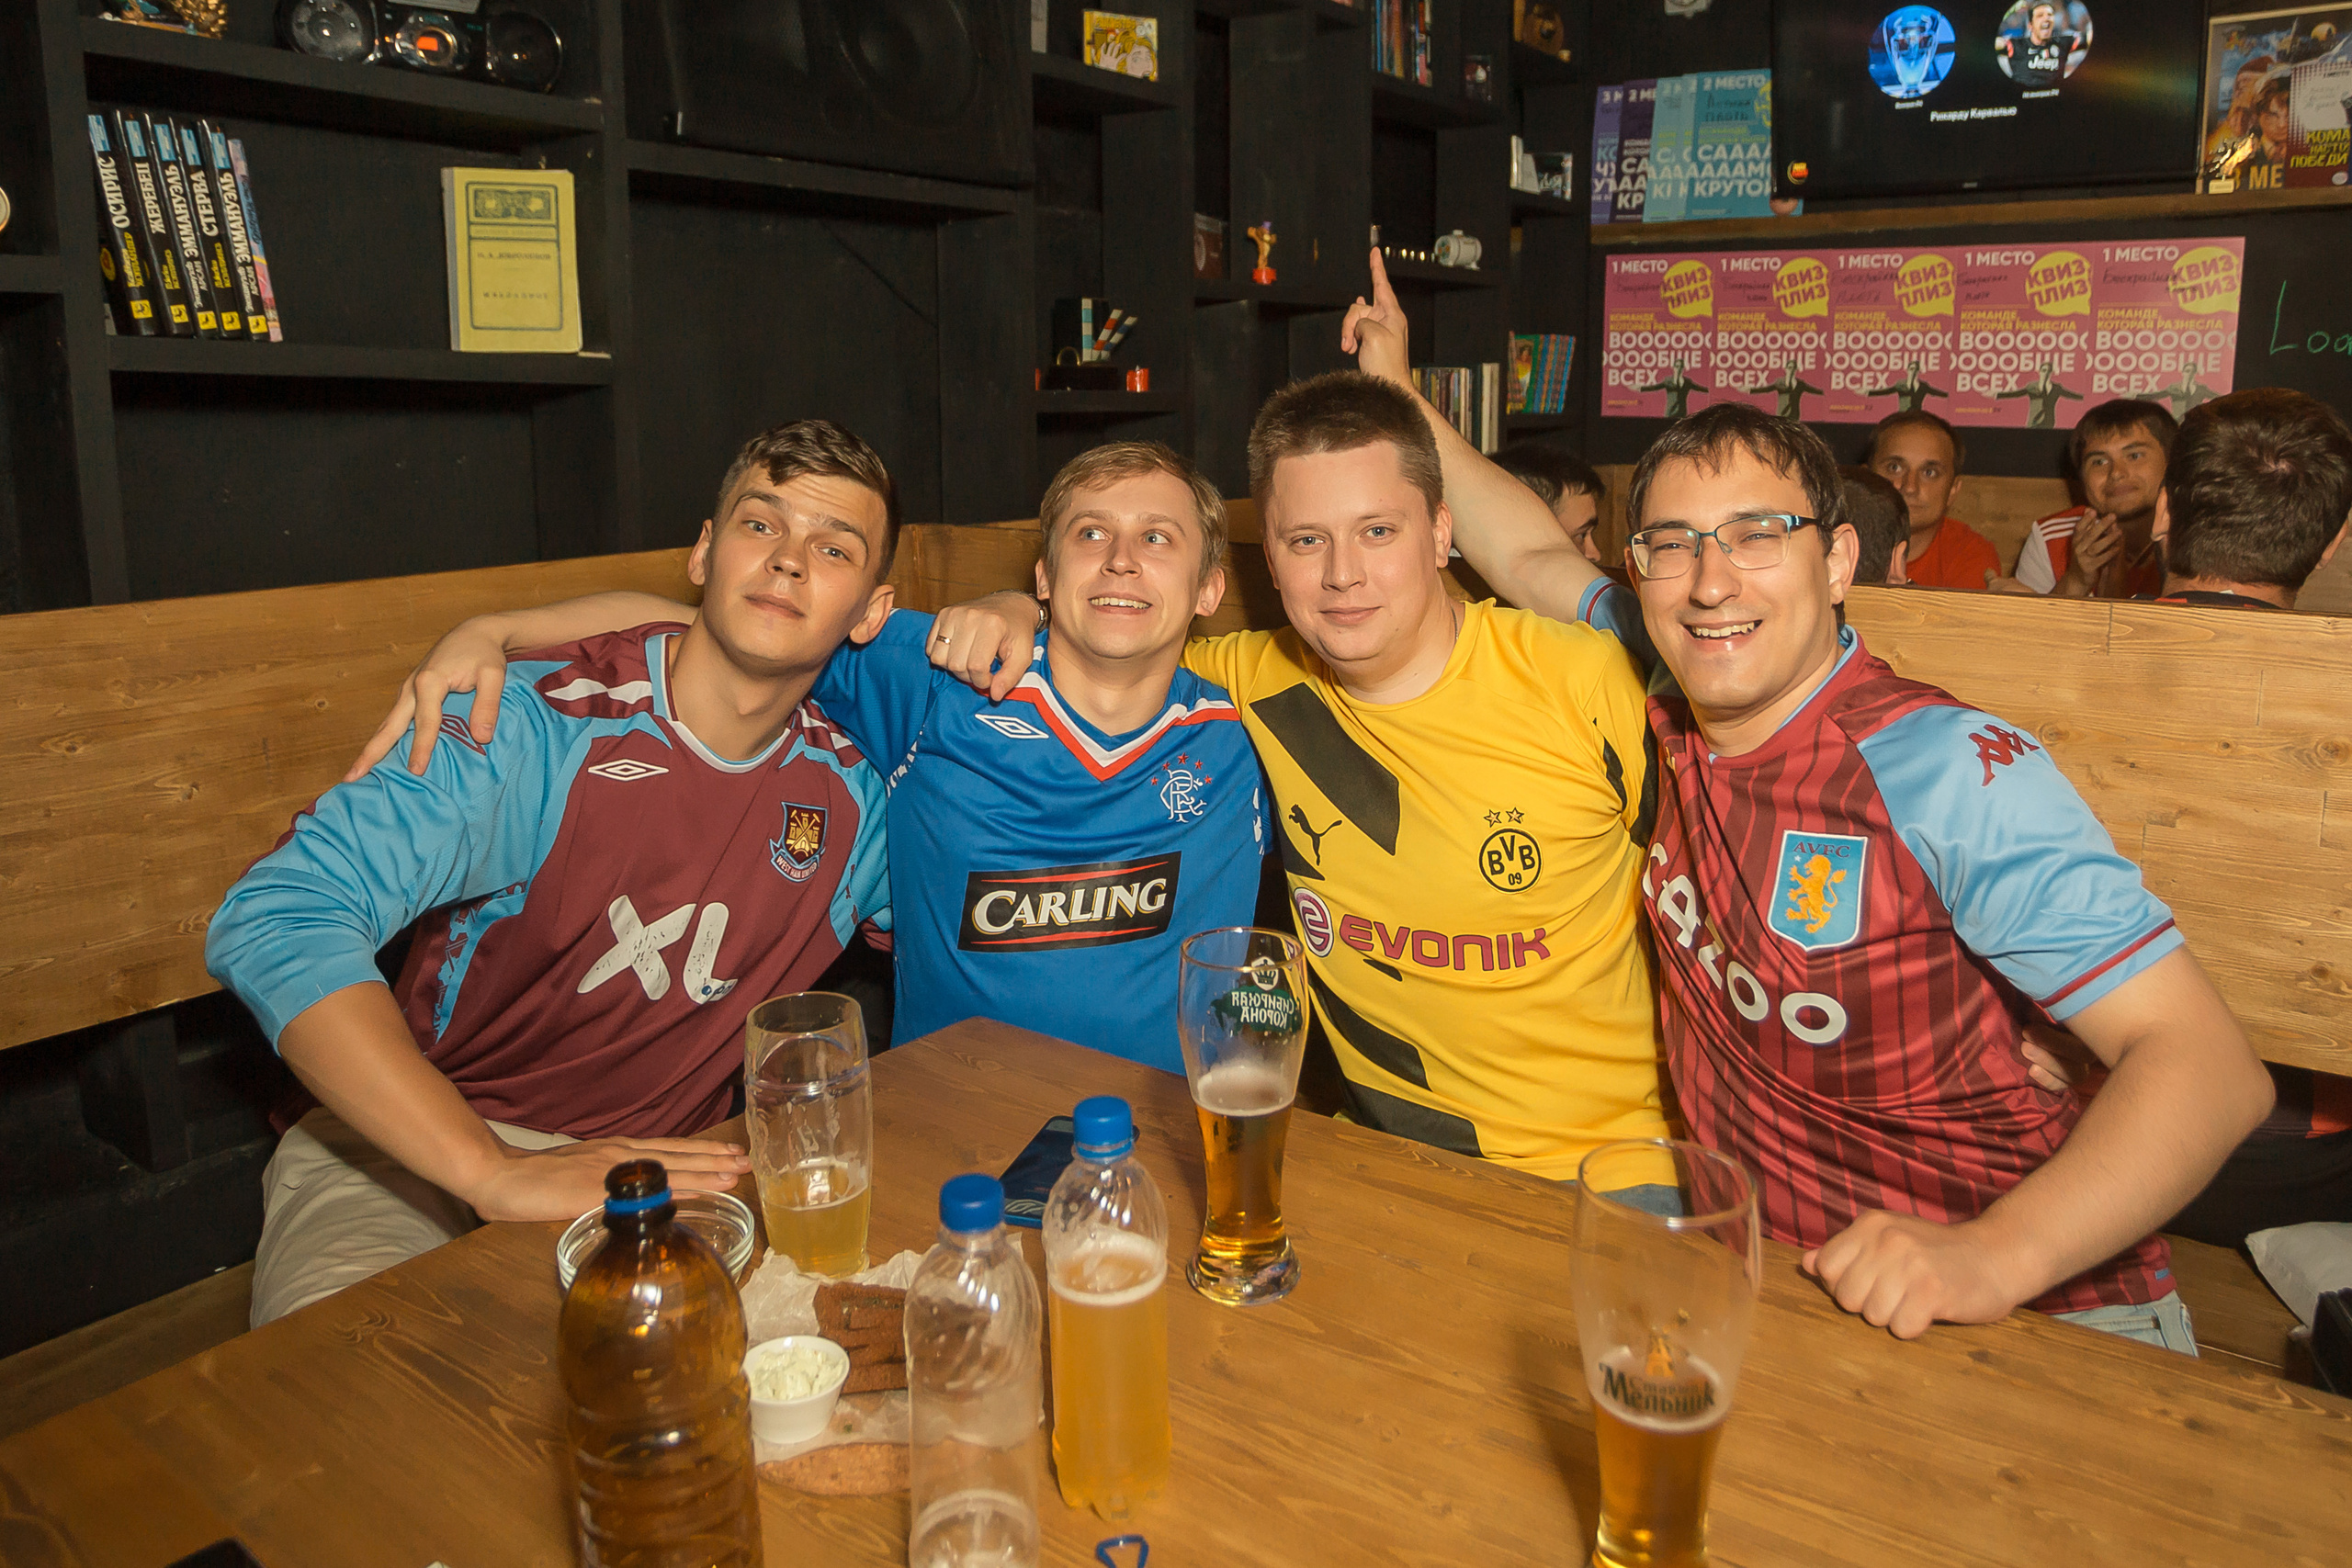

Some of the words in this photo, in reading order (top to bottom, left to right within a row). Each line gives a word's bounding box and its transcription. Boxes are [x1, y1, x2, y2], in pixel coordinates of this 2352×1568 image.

[2028, 58, 2059, 71] Jeep
[1715, 73, 1767, 90] МЕСТО
[96, 155, 130, 230] ОСИРИС
[135, 162, 166, 235] ЖЕРЕБЕЦ
[190, 169, 219, 237] СТЕРВА
[164, 164, 199, 259] ЭММАНУЭЛЬ
[219, 172, 252, 265] ЭММАНУЭЛЬ
[1612, 261, 1619, 274] 1
[1621, 259, 1668, 274] МЕСТО
[1721, 258, 1726, 272] 1
[1730, 256, 1781, 272] МЕСТО
[1838, 254, 1845, 269] 1
[1849, 253, 1904, 269] МЕСТО
[1965, 252, 1973, 266] 1
[1976, 251, 2036, 266] МЕСТО
[2102, 247, 2110, 263] 1
[2115, 245, 2179, 263] МЕСТО
[1664, 265, 1709, 293] КВИЗ
[1774, 265, 1824, 293] КВИЗ
[1896, 262, 1950, 291] КВИЗ
[2029, 258, 2086, 289] КВИЗ
[2173, 254, 2234, 285] КВИЗ
[1664, 284, 1712, 310] ПЛИЗ
[1776, 283, 1827, 309] ПЛИЗ
[1895, 280, 1952, 308] ПЛИЗ
[2030, 278, 2089, 307] ПЛИЗ
[1608, 369, 1659, 387] ВСЕХ
[1715, 369, 1770, 389] ВСЕХ
[1831, 371, 1890, 390] ВСЕХ
[1956, 372, 2020, 393] ВСЕХ
[2092, 373, 2162, 394] ВСЕХ
[1487, 834, 1536, 876] BVB
[1792, 840, 1850, 859] AVFC
[776, 855, 792, 874] WEST
[1508, 872, 1523, 886] 09
[576, 894, 739, 1005] XL
[1339, 914, 1551, 972] EVONIK
